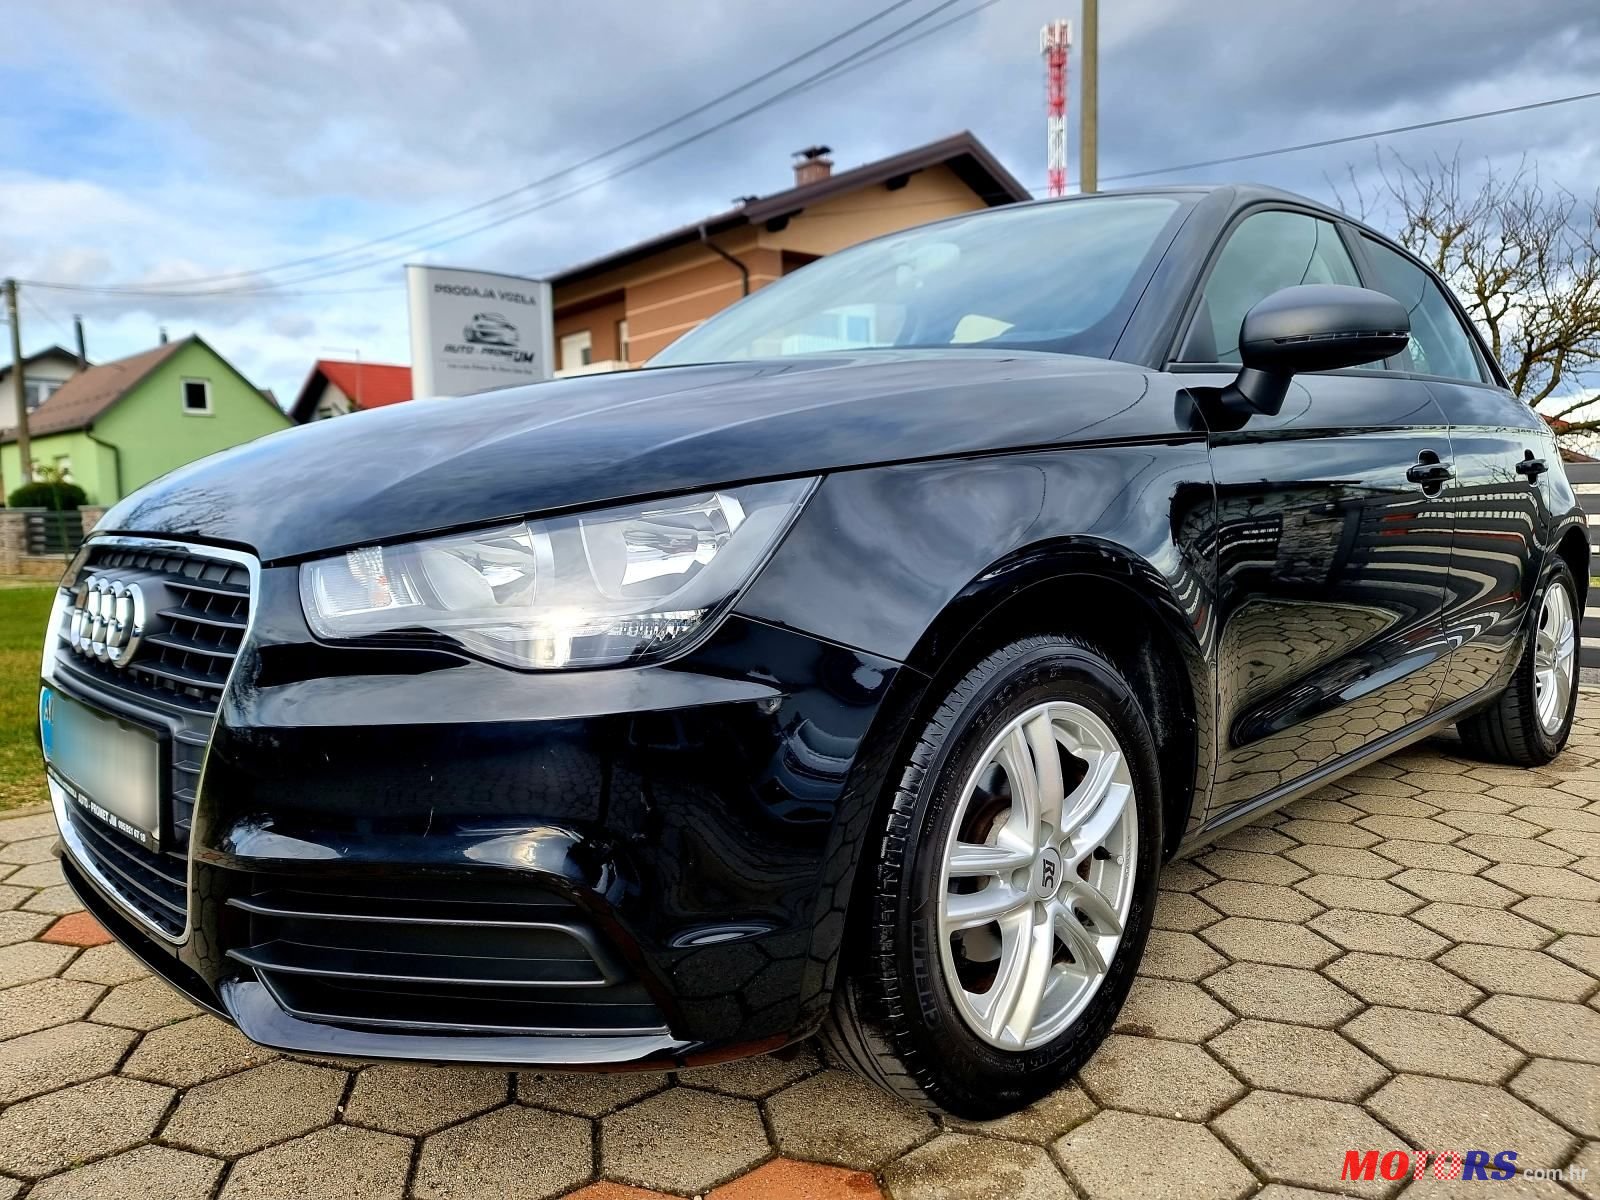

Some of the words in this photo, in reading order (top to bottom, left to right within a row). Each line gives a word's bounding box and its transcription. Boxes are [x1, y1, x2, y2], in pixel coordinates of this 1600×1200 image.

[434, 283, 496, 299] PRODAJA
[443, 343, 475, 354] AUTO
[78, 792, 88, 809] AUTO
[90, 801, 109, 822] PROMET
[1042, 858, 1055, 888] RC
